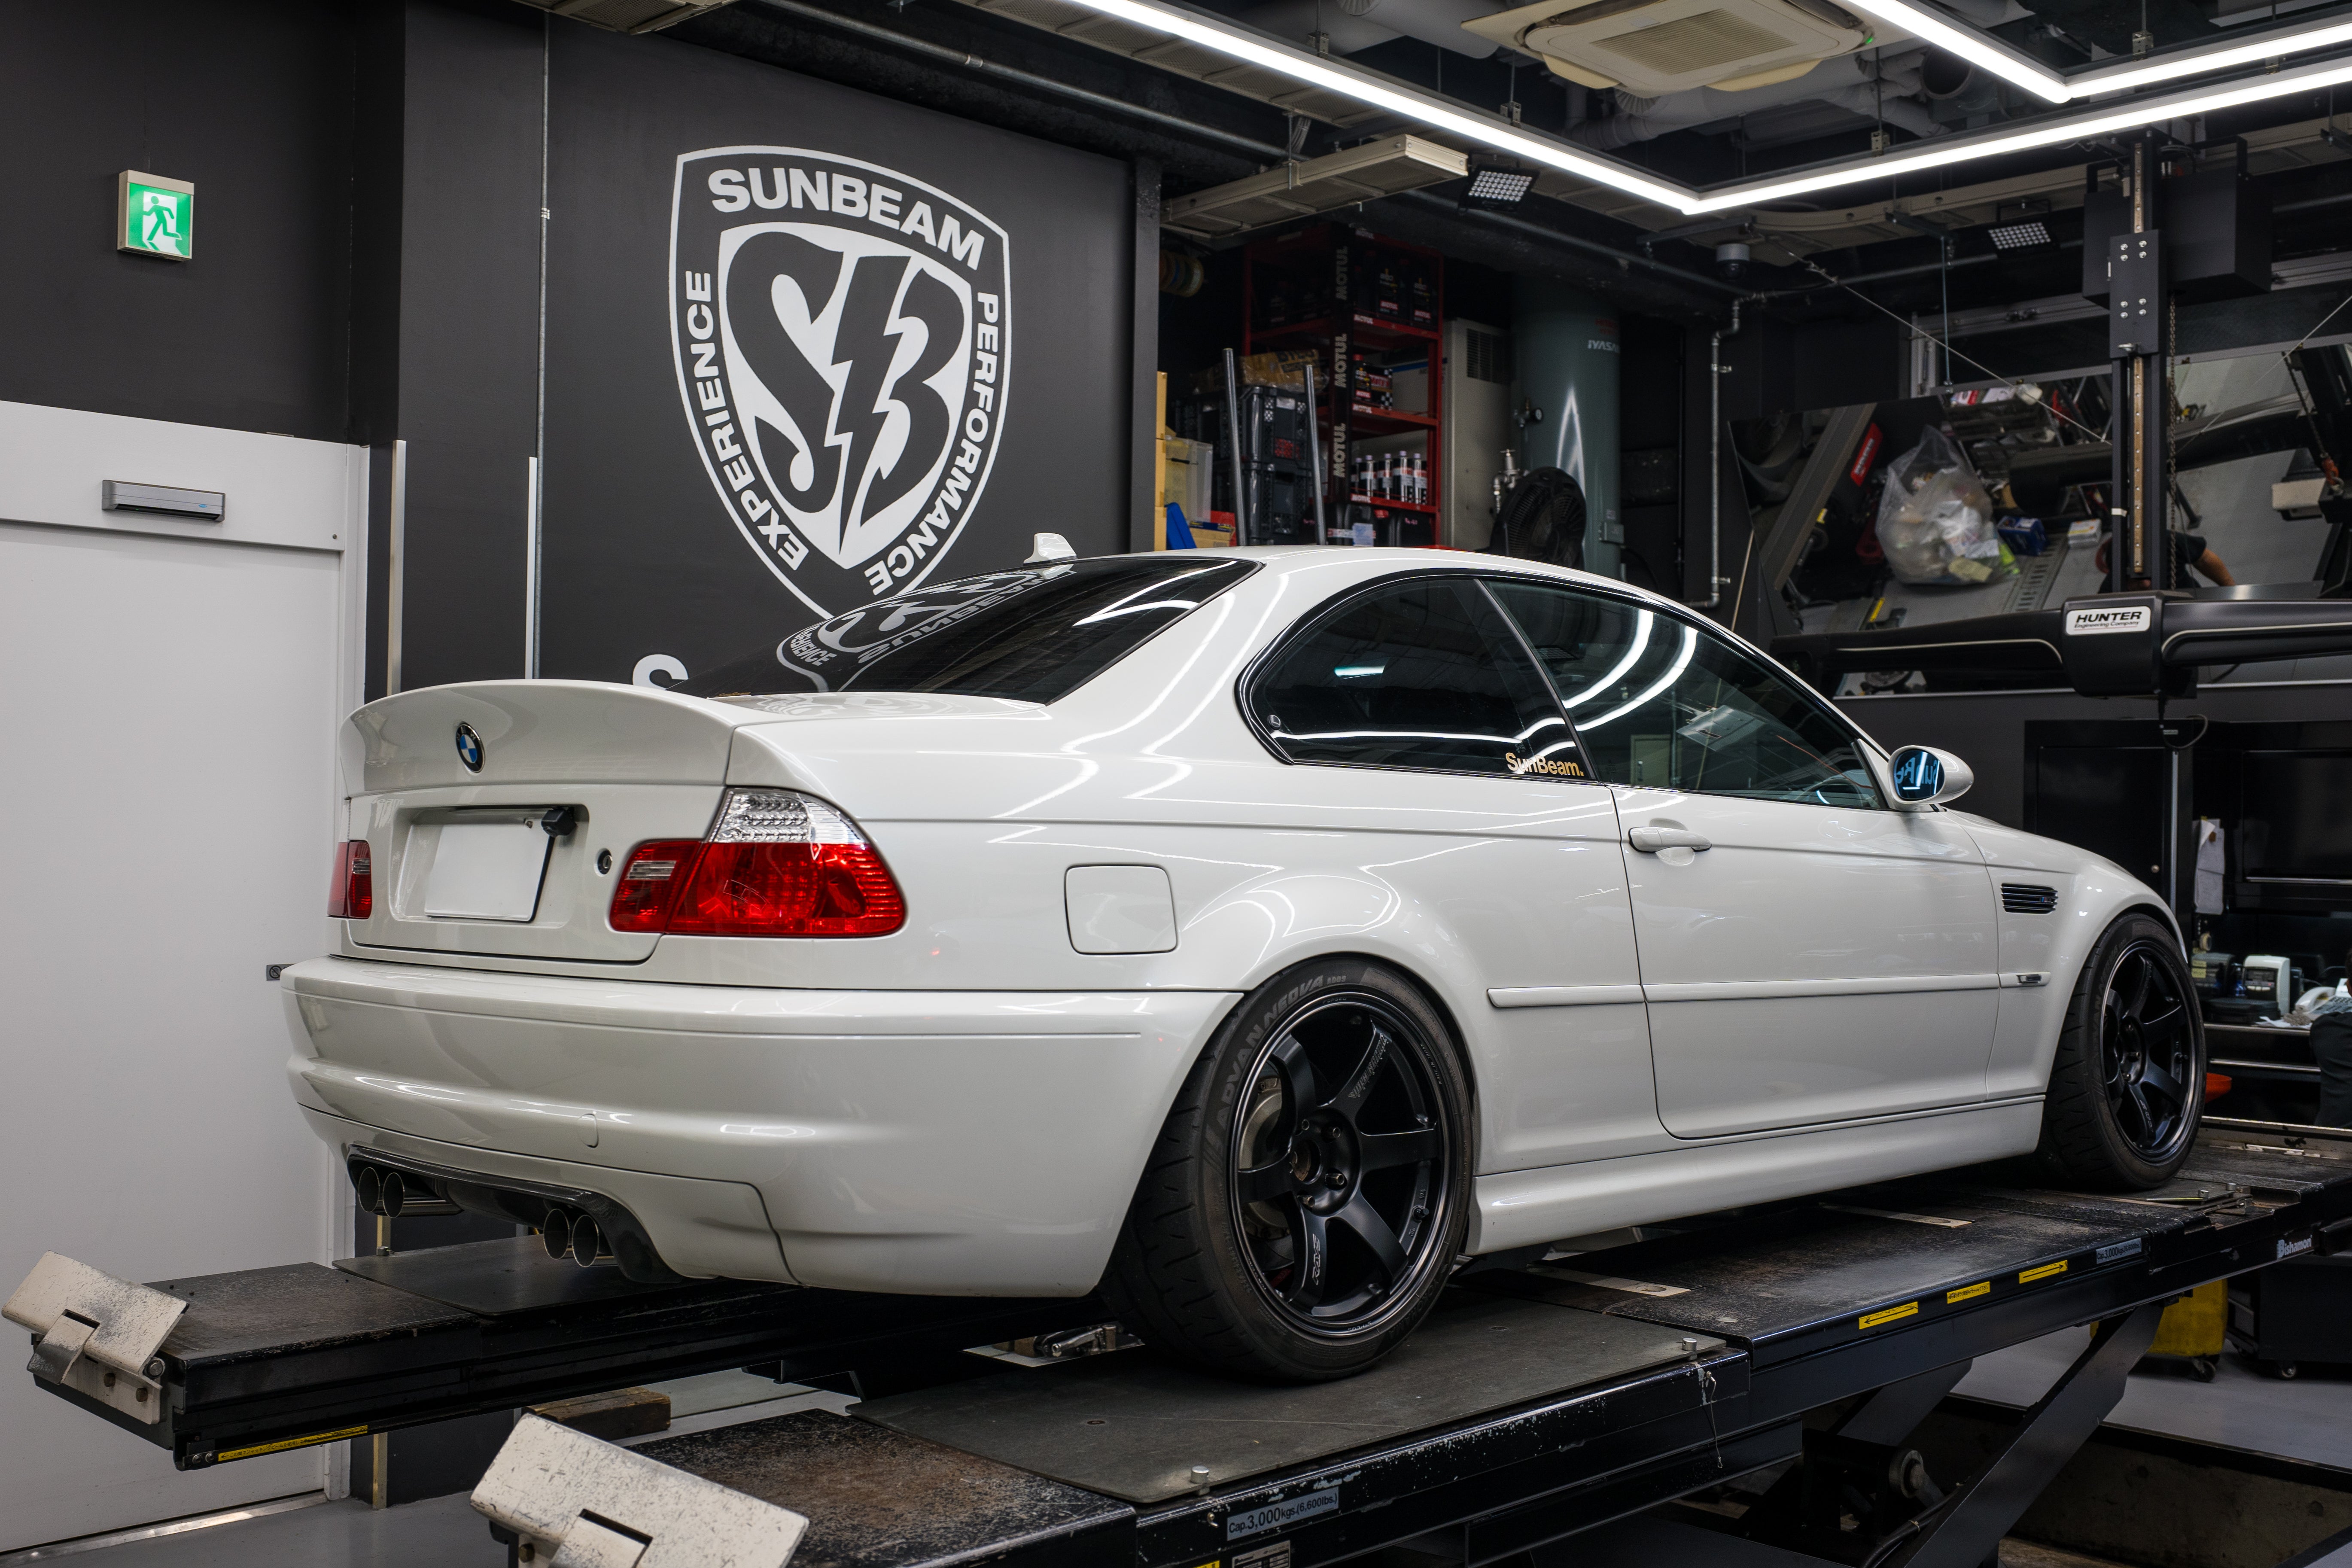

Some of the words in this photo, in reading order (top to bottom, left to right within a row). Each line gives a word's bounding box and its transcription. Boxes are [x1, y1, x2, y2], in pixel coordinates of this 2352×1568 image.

[708, 167, 985, 270] SUNBEAM
[1336, 246, 1348, 300] MOTUL
[1335, 334, 1347, 388] MOTUL
[686, 271, 809, 570] EXPERIENCE
[864, 292, 999, 595] PERFORMANCE
[1333, 423, 1346, 478] MOTUL
[2076, 612, 2142, 623] HUNTER
[1216, 1024, 1264, 1131] ADVAN
[1264, 975, 1324, 1029] NEOVA
[2276, 1236, 2312, 1260] Bishamon
